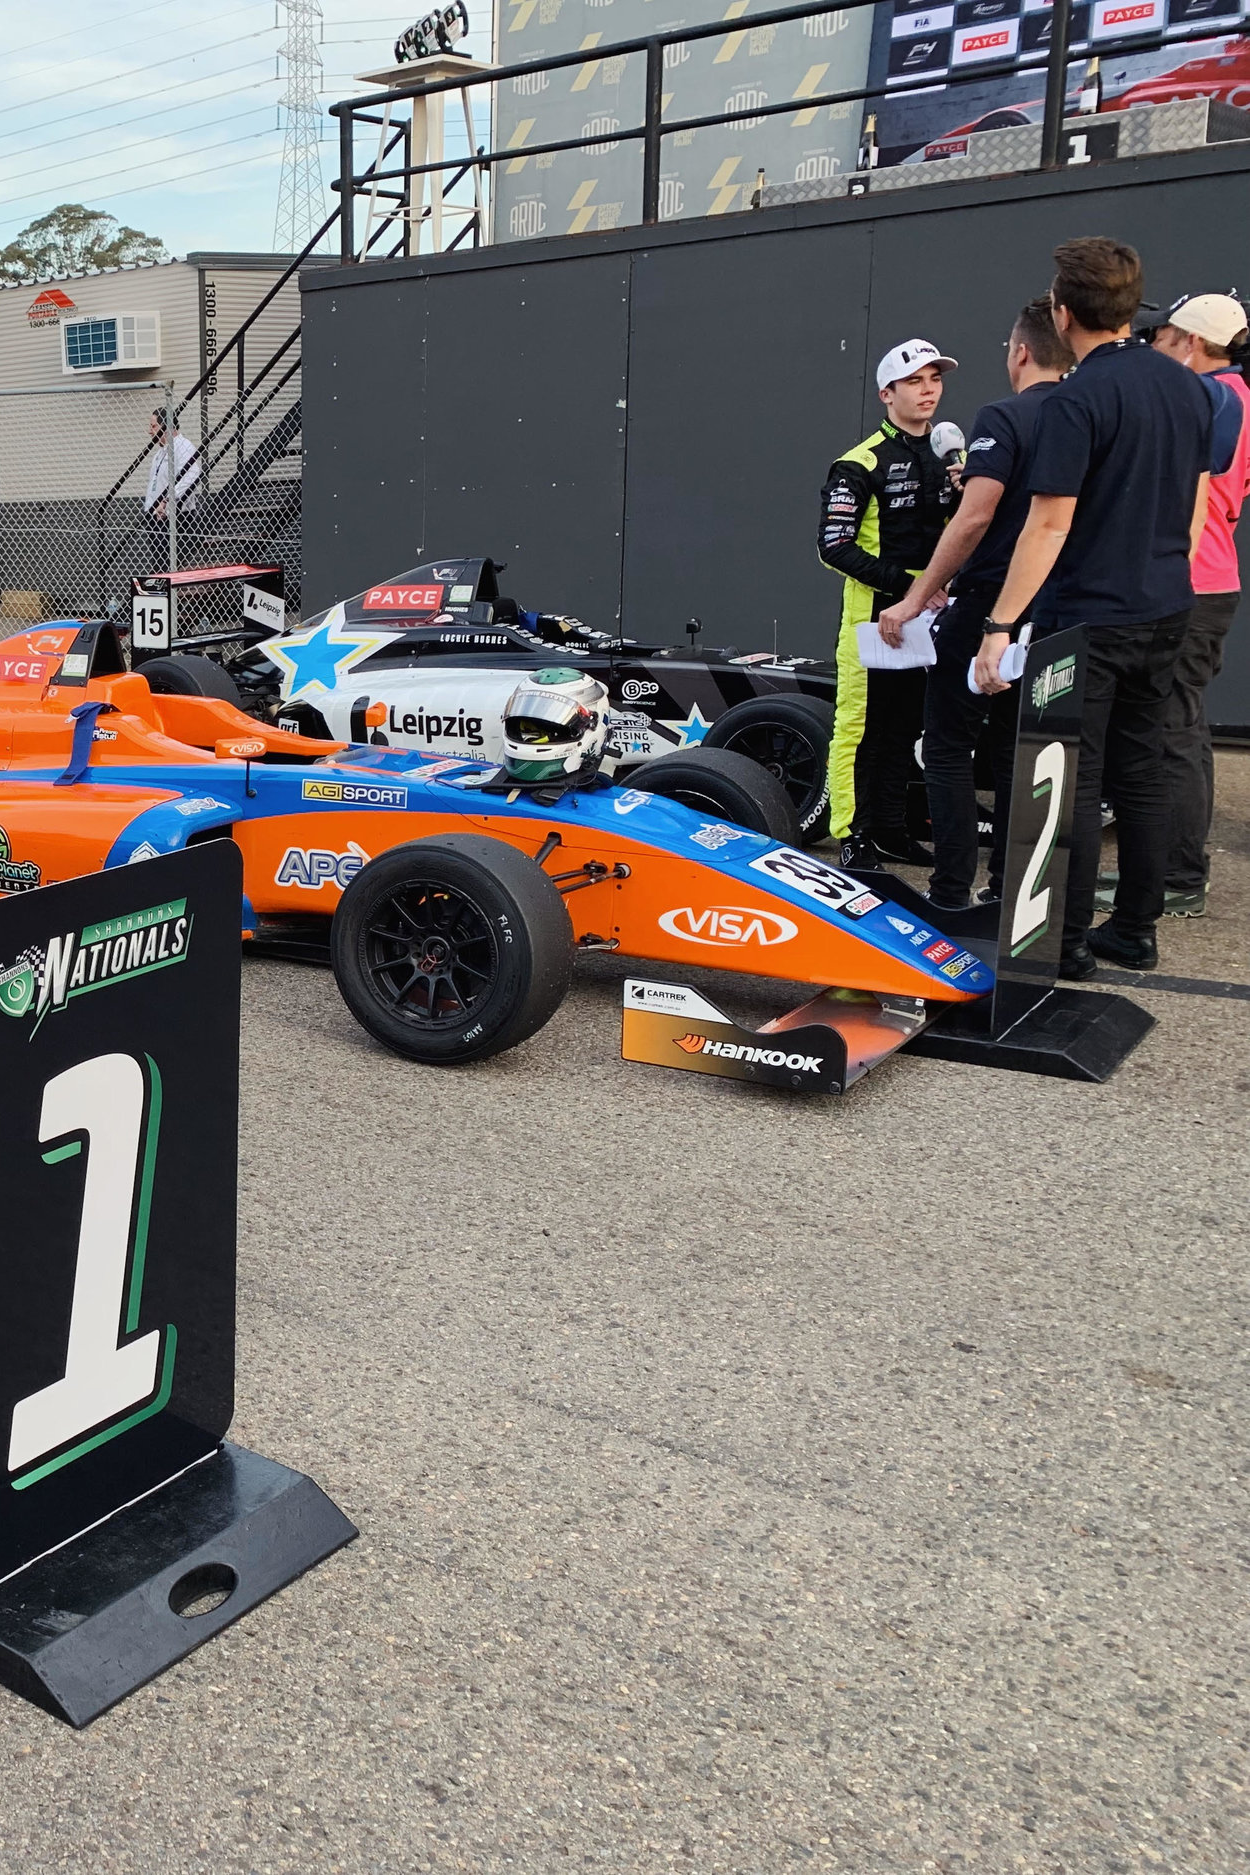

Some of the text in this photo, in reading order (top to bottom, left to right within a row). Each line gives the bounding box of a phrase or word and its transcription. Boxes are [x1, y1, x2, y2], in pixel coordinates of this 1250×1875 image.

[1105, 6, 1152, 22] PAYCE
[963, 33, 1008, 50] PAYCE
[926, 141, 965, 156] PAYCE
[1068, 134, 1092, 165] 1
[510, 201, 547, 237] ARDC
[259, 597, 282, 618] Leipzig
[368, 590, 439, 606] PAYCE
[135, 607, 164, 638] 15
[390, 705, 484, 746] Leipzig
[612, 731, 649, 741] RISING
[306, 784, 404, 804] AGI SPORT
[1011, 742, 1066, 946] 2
[763, 852, 856, 900] 39
[94, 904, 174, 939] SHANNONS
[684, 907, 771, 947] VISA
[36, 916, 188, 1017] NATIONALS
[926, 942, 955, 962] PAYCE
[646, 989, 687, 1002] CARTREK
[7, 1052, 161, 1473] 1
